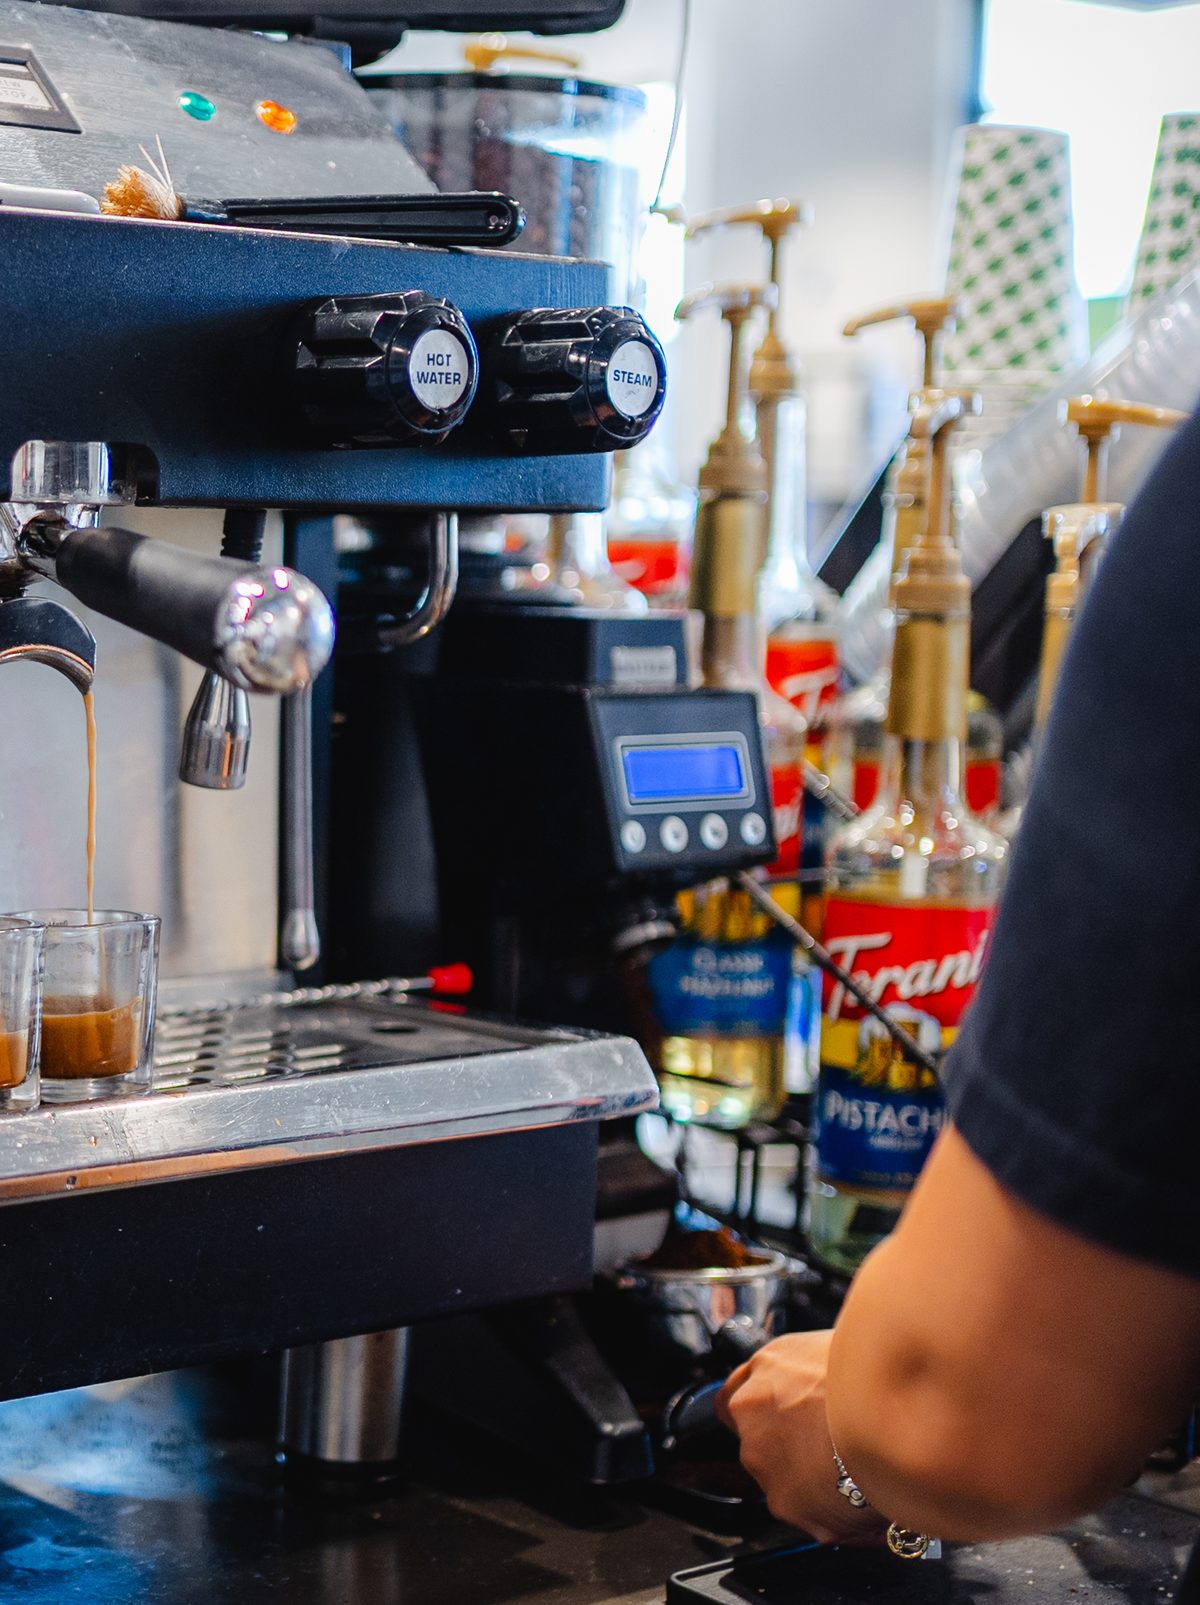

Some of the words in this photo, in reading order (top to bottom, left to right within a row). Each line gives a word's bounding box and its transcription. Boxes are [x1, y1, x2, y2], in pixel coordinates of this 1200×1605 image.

[427, 353, 452, 367] HOT
[416, 371, 461, 385] WATER
[613, 369, 652, 388] STEAM
